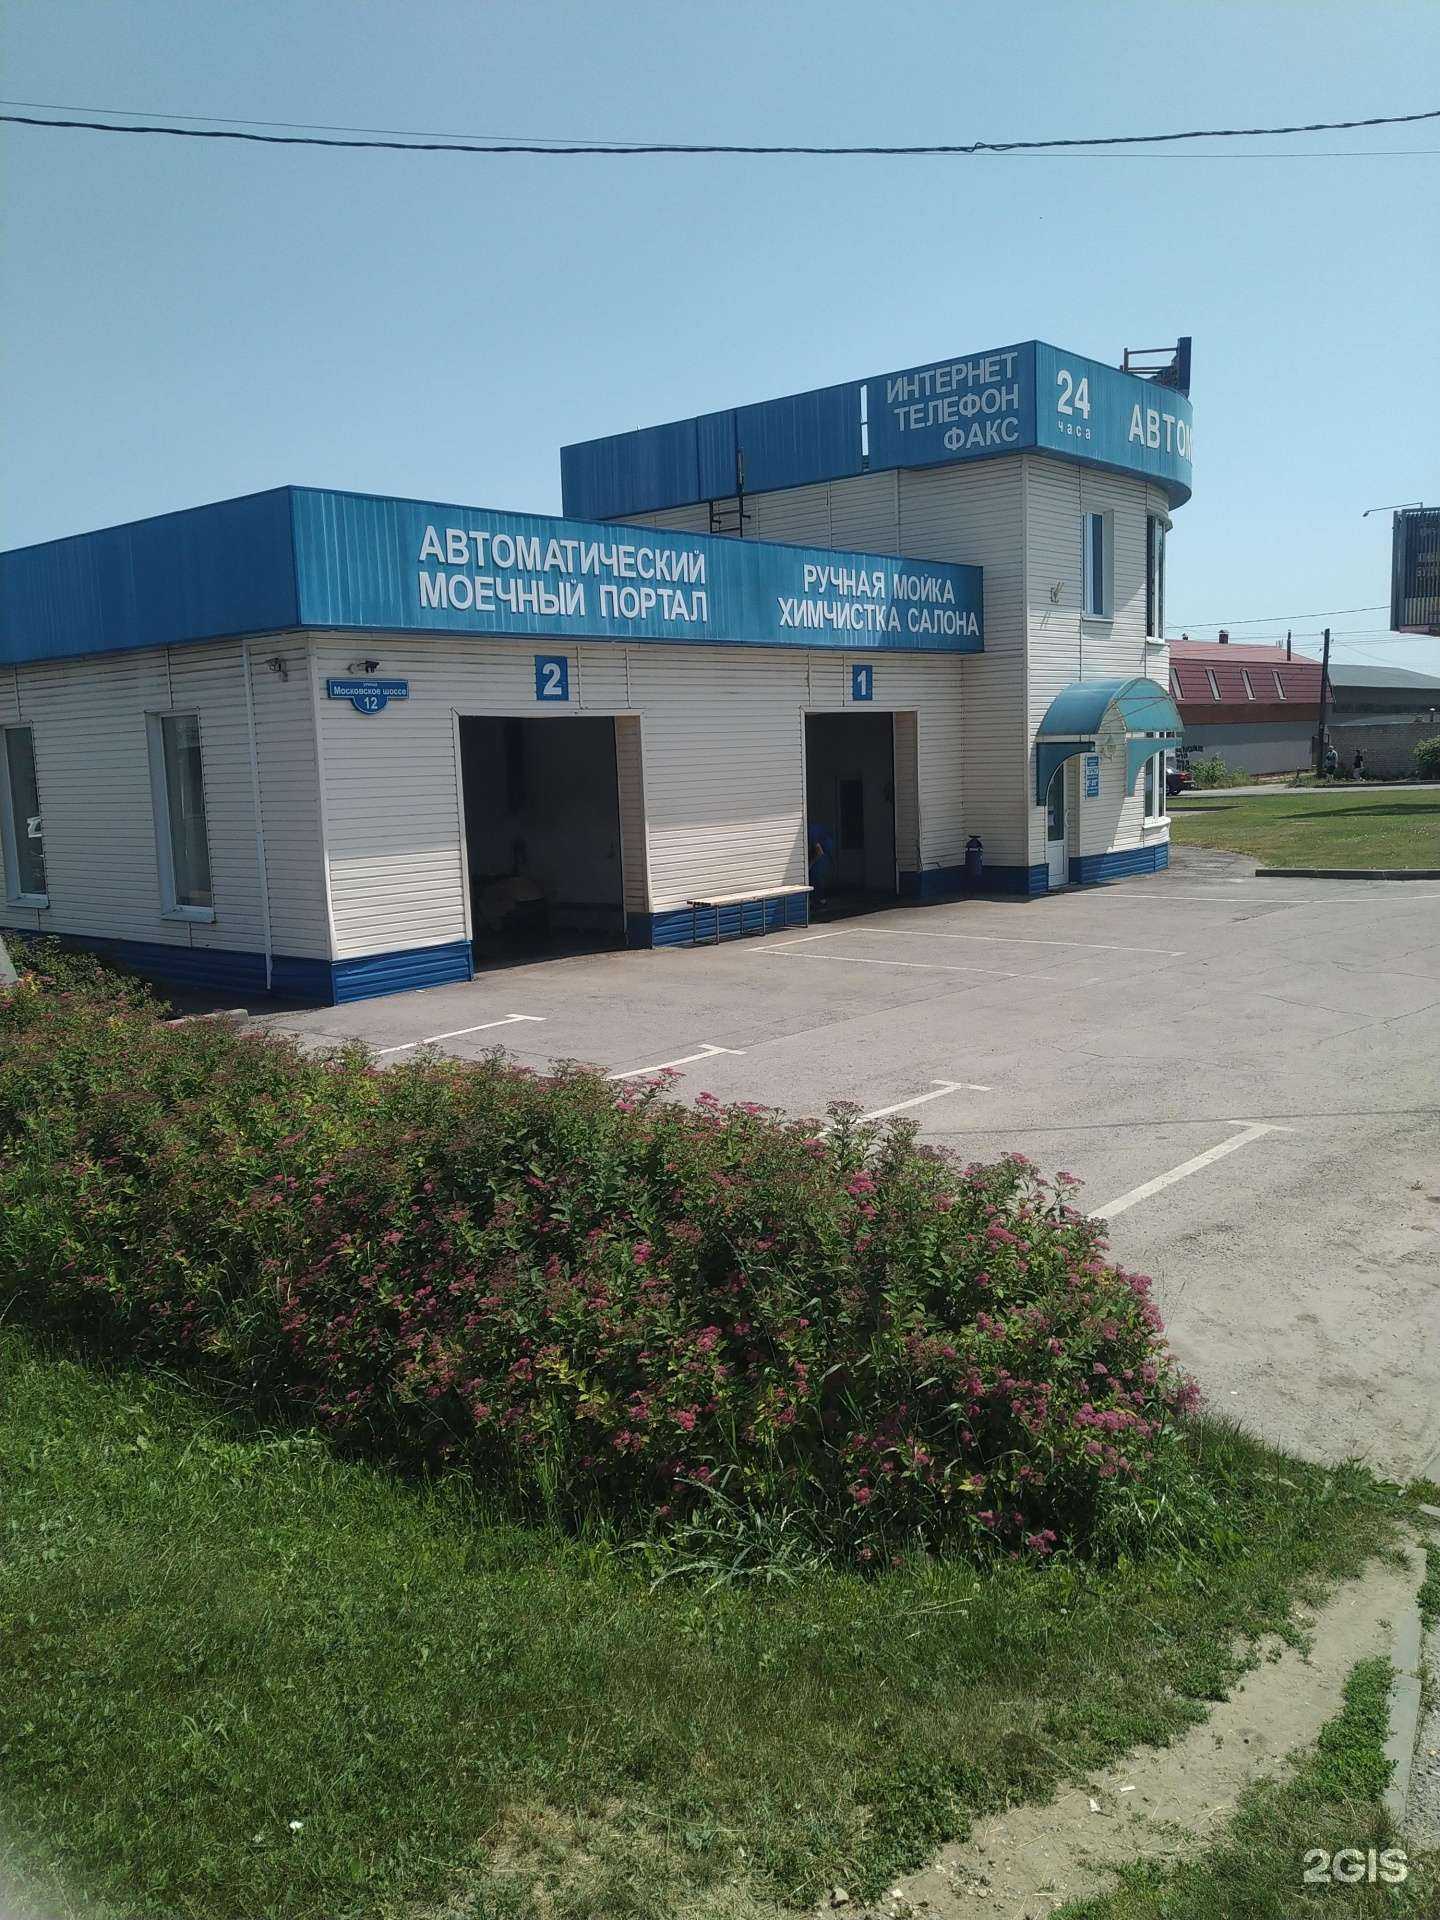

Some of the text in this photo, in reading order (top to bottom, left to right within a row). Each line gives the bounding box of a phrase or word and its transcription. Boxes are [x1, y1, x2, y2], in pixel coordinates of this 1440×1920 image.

[887, 352, 1018, 404] ИНТЕРНЕТ
[1056, 369, 1091, 420] 24
[894, 383, 1019, 432] ТЕЛЕФОН
[943, 416, 1019, 450] ФАКС
[1057, 420, 1091, 441] часа
[418, 525, 706, 585] АВТОМАТИЧЕСКИЙ
[419, 571, 708, 623] МОЕЧНЫЙ ПОРТАЛ
[803, 564, 956, 605] РУЧНАЯ МОЙКА
[777, 597, 980, 636] ХИМЧИСТКА САЛОНА
[333, 686, 380, 695] Московское
[542, 662, 562, 695] 2
[857, 670, 867, 696] 1
[364, 697, 378, 709] 12
